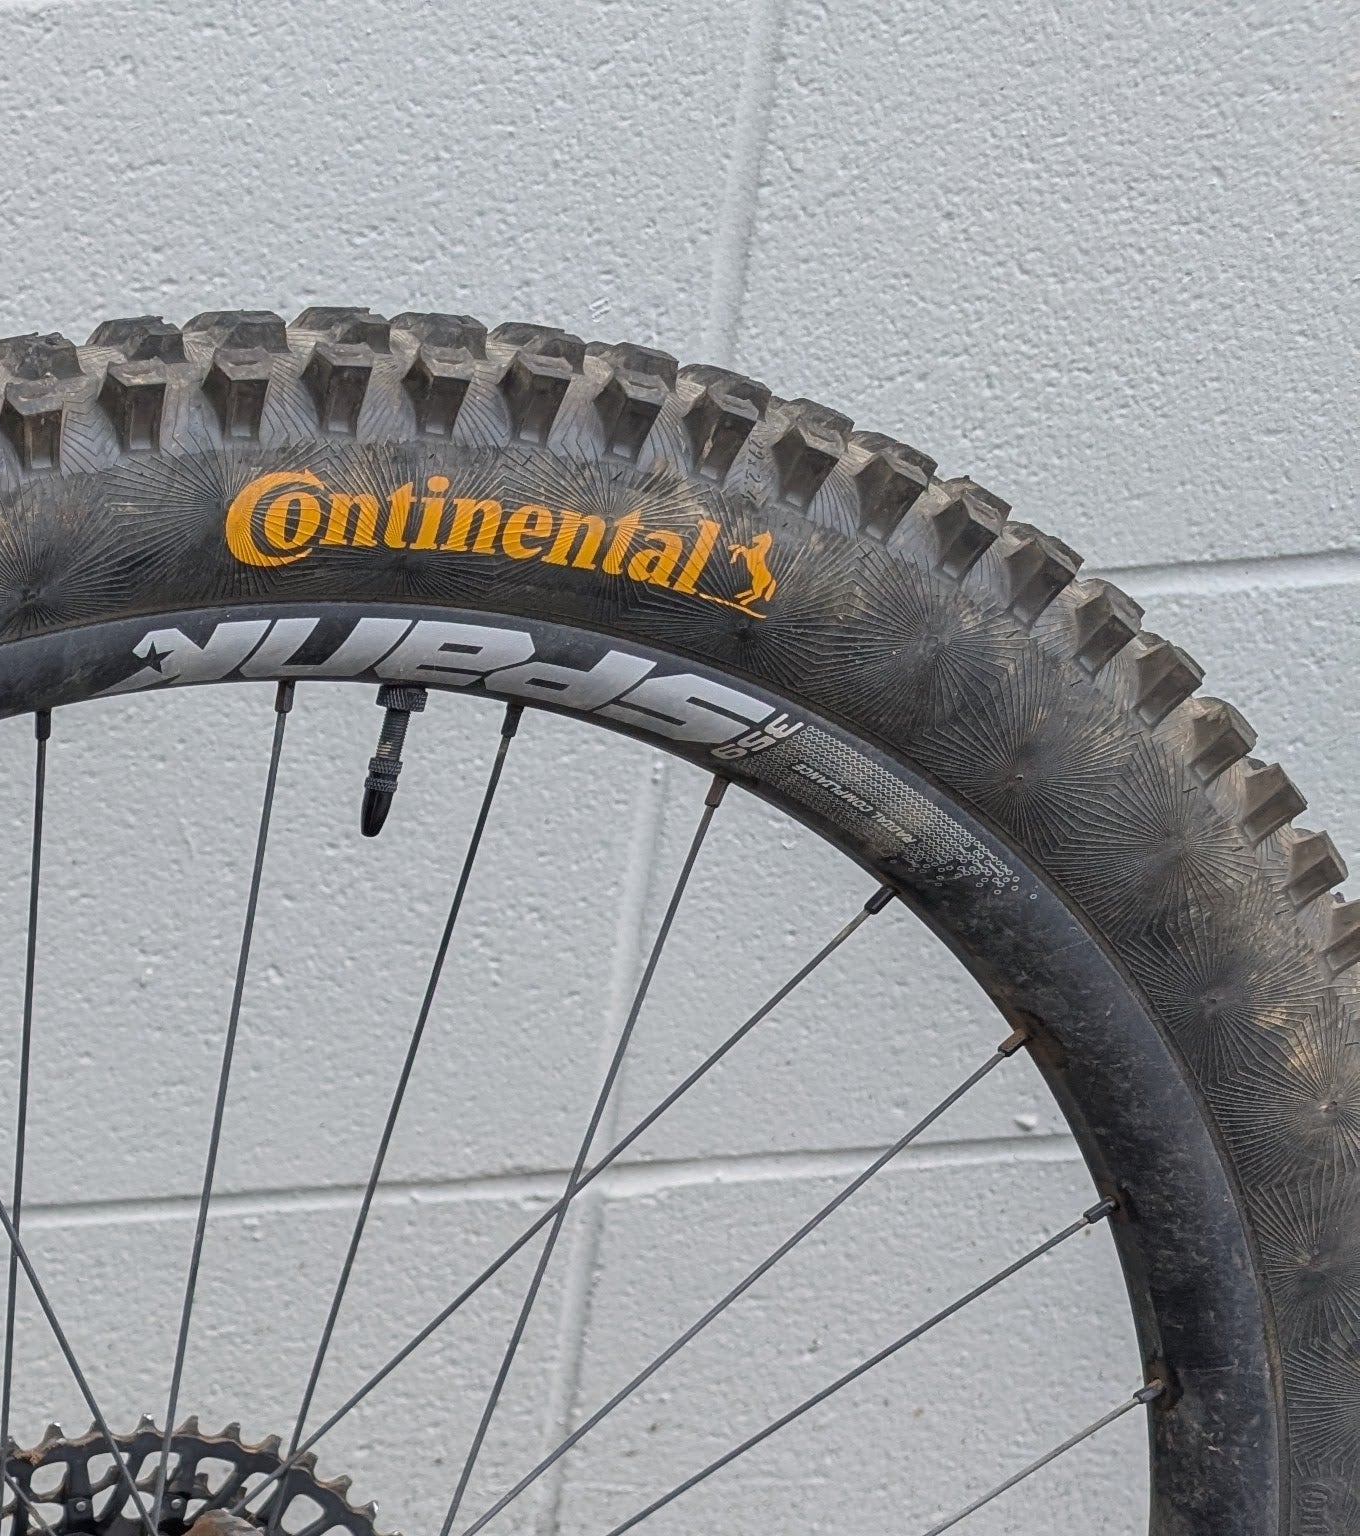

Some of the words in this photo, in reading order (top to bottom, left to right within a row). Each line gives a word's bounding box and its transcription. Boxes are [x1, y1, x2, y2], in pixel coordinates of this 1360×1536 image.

[225, 470, 723, 595] Continental
[710, 713, 805, 760] 359
[791, 763, 874, 816] COMPLIANCE
